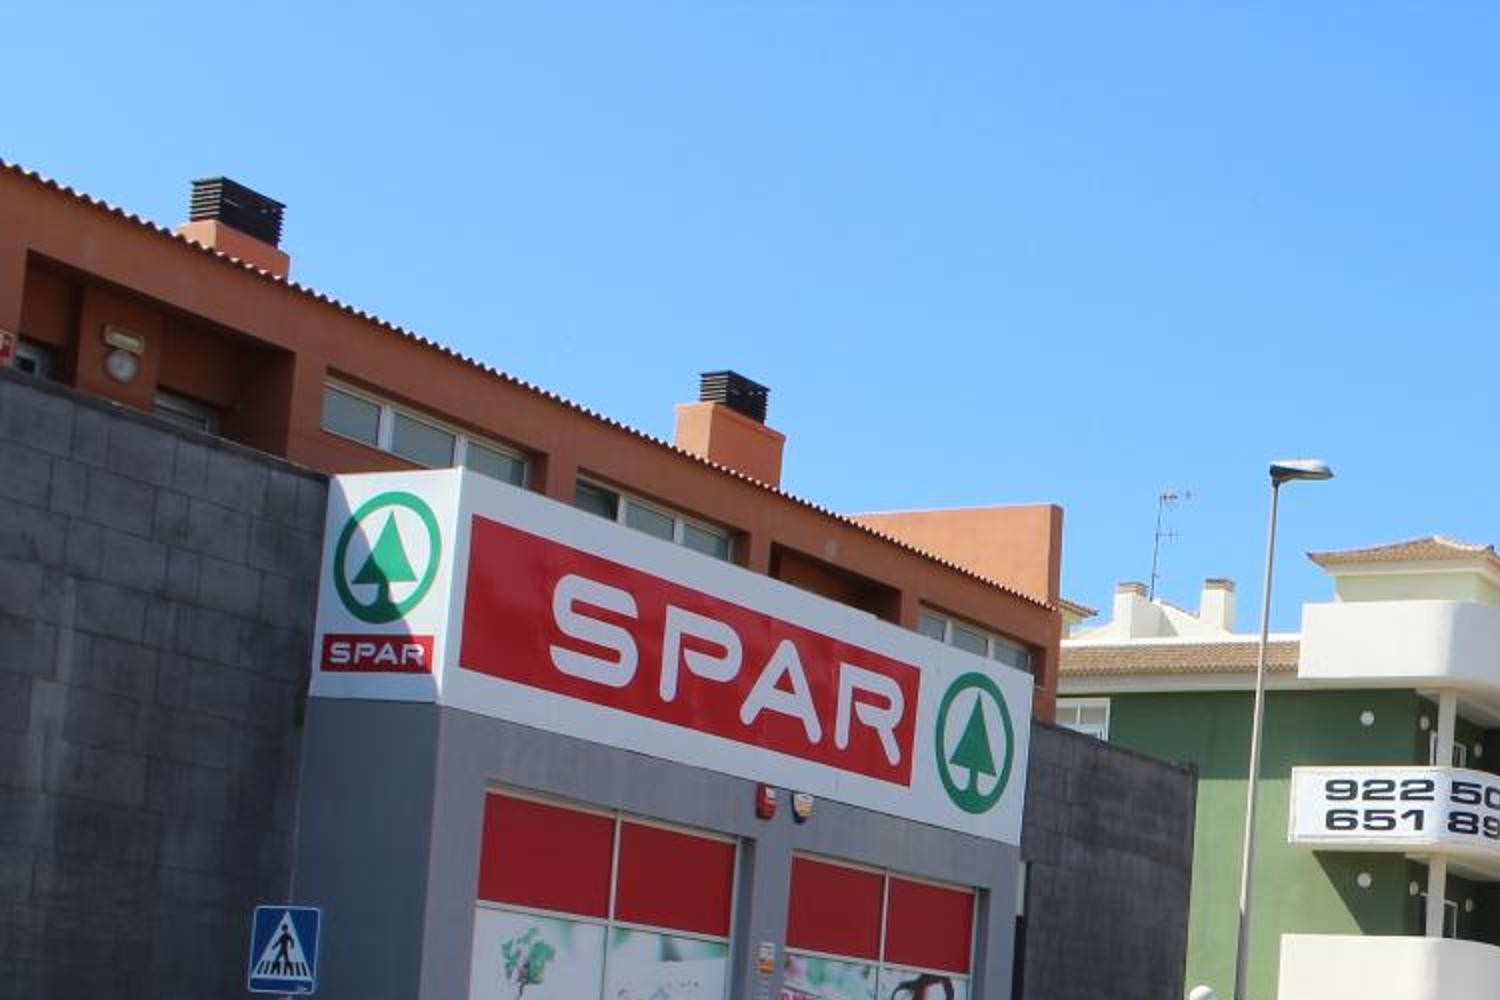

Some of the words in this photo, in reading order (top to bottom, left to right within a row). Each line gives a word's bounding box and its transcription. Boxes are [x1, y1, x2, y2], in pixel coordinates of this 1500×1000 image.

[330, 641, 425, 667] SPAR
[549, 573, 905, 766] SPAR
[1325, 779, 1435, 801] 922
[1325, 809, 1425, 831] 651
